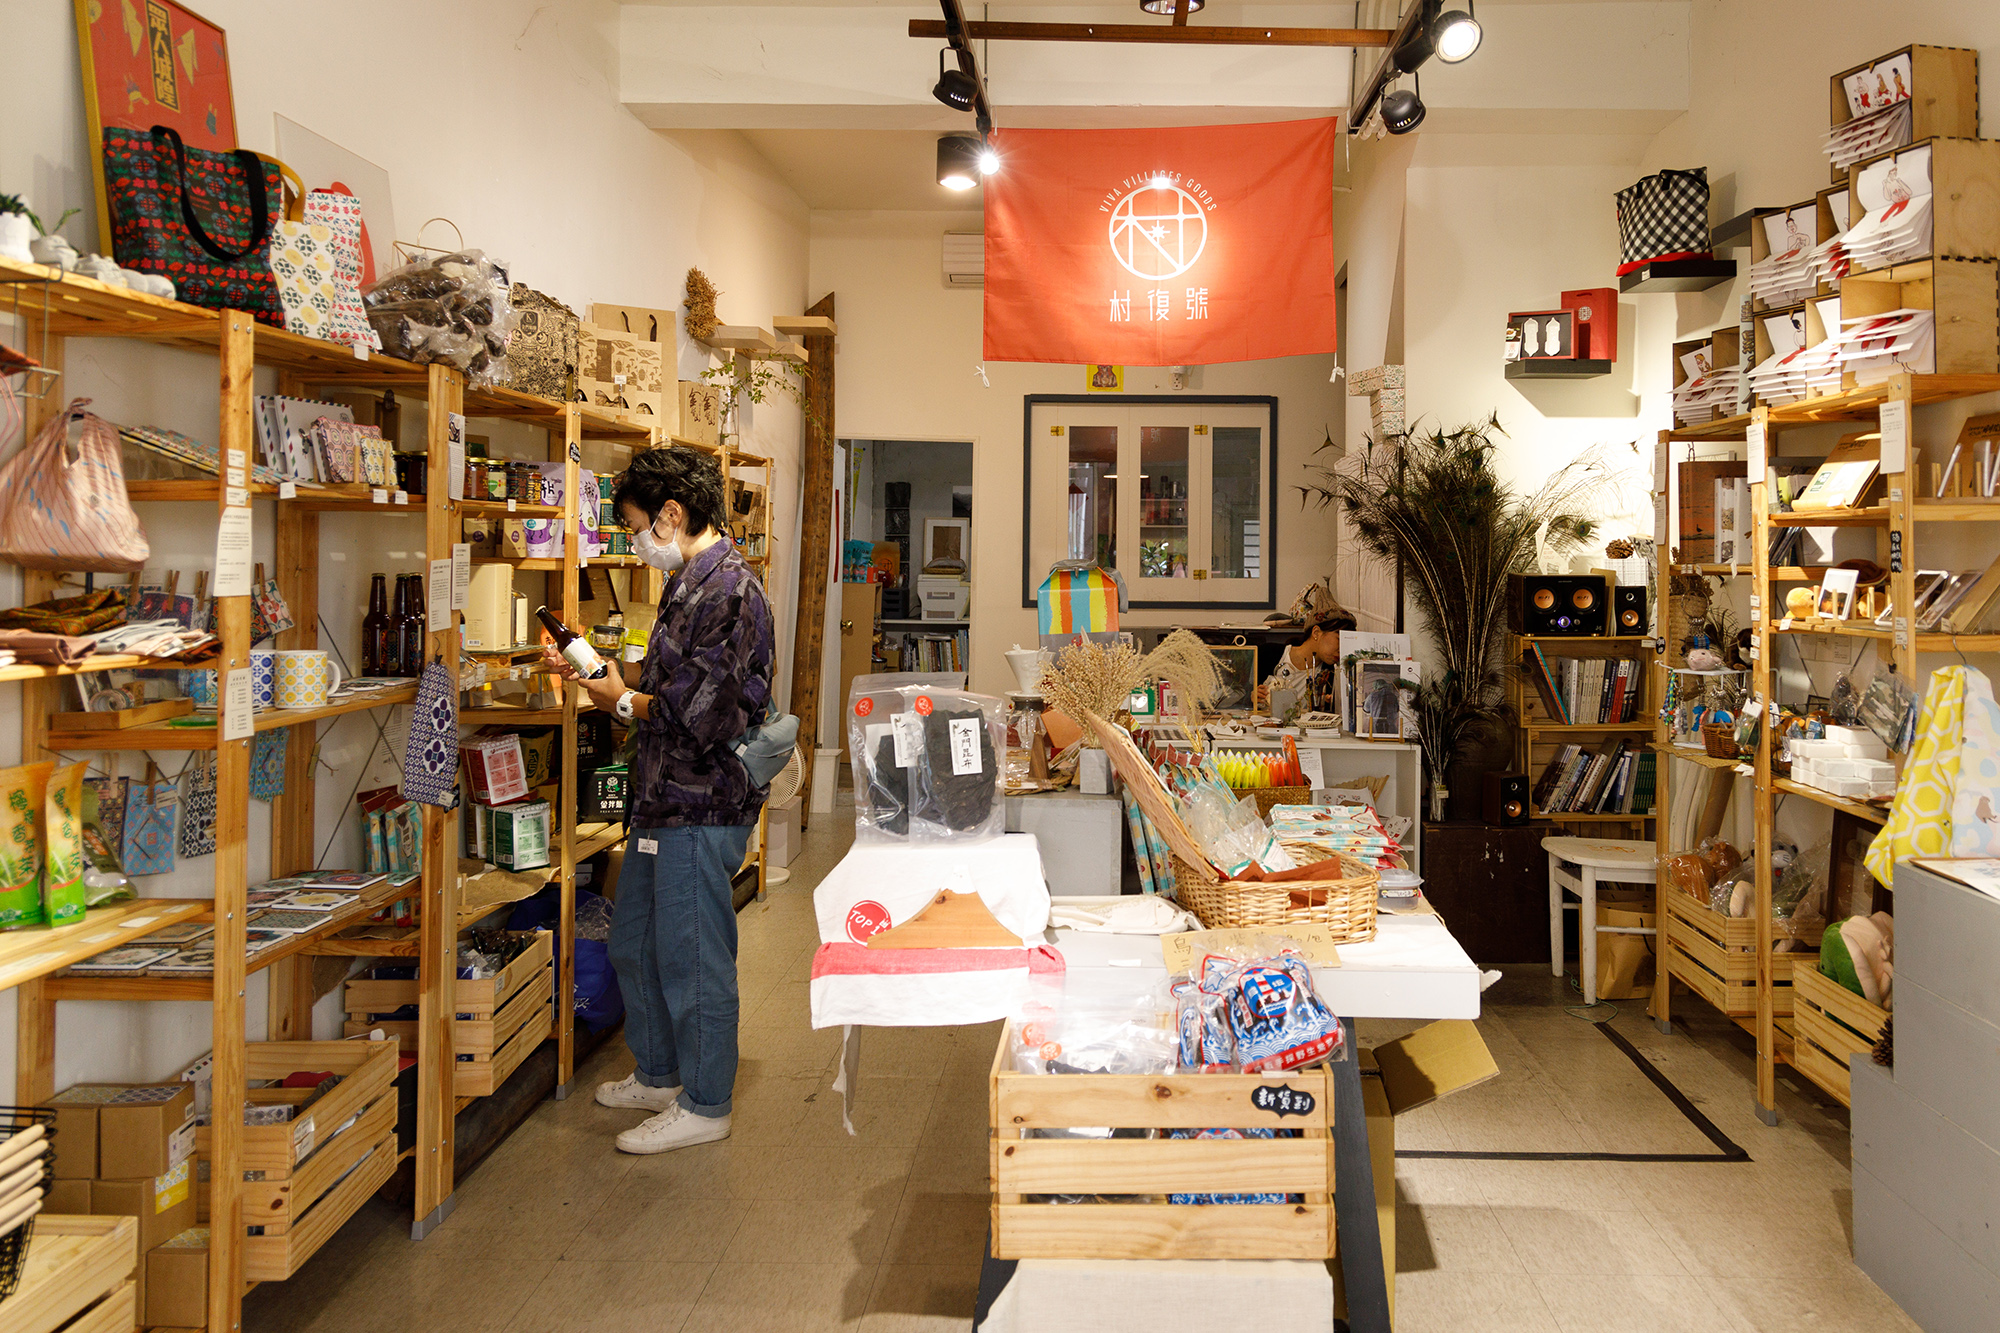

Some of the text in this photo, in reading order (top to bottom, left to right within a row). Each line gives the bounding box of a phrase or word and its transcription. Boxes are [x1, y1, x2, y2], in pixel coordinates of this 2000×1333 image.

[1099, 169, 1218, 213] VIVA VILLAGES GOODS
[1109, 287, 1209, 322] 村復號
[957, 727, 974, 769] 金門昆布
[849, 909, 881, 936] TOP 1
[1258, 1086, 1312, 1112] 新貨到
